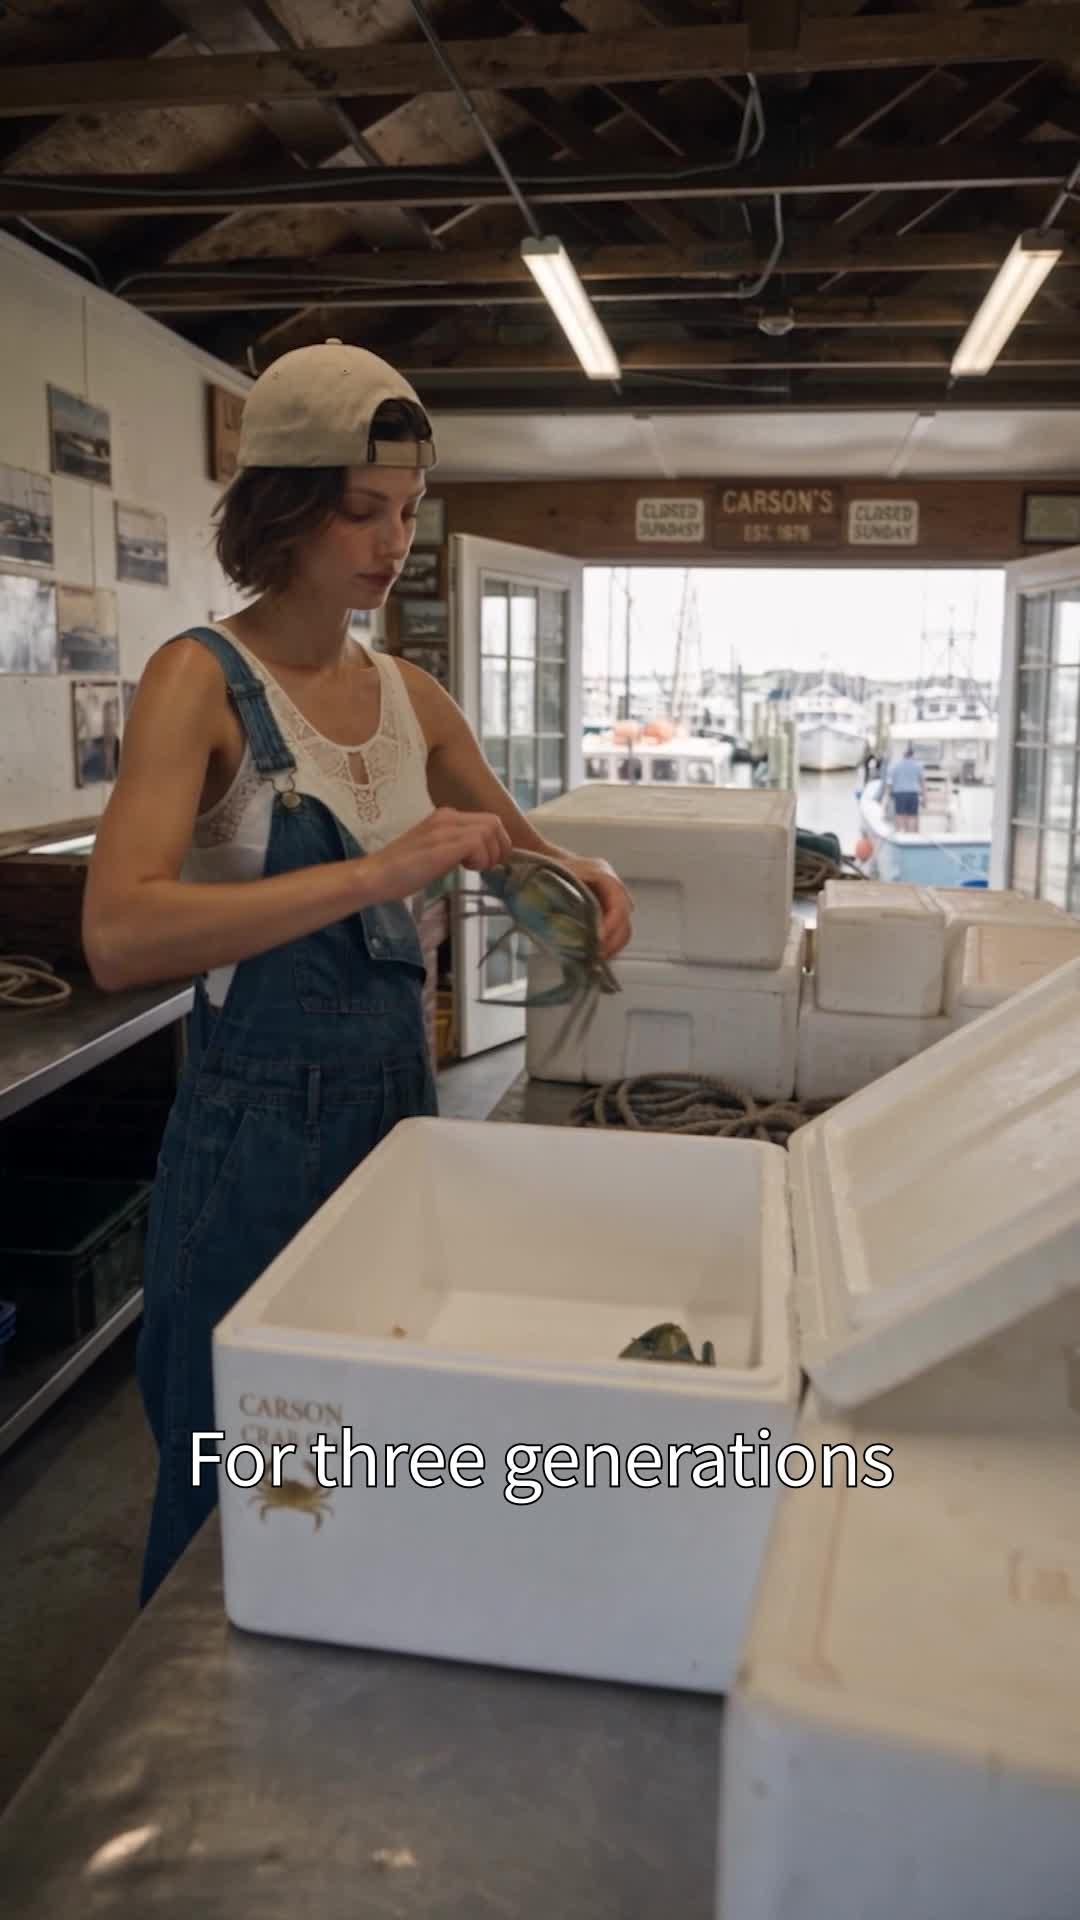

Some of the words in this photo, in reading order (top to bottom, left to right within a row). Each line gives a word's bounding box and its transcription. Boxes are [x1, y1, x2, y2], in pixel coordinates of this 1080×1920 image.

[722, 488, 832, 514] CARSON'S
[855, 504, 913, 521] CLOSED
[239, 1392, 343, 1426] CARSON
